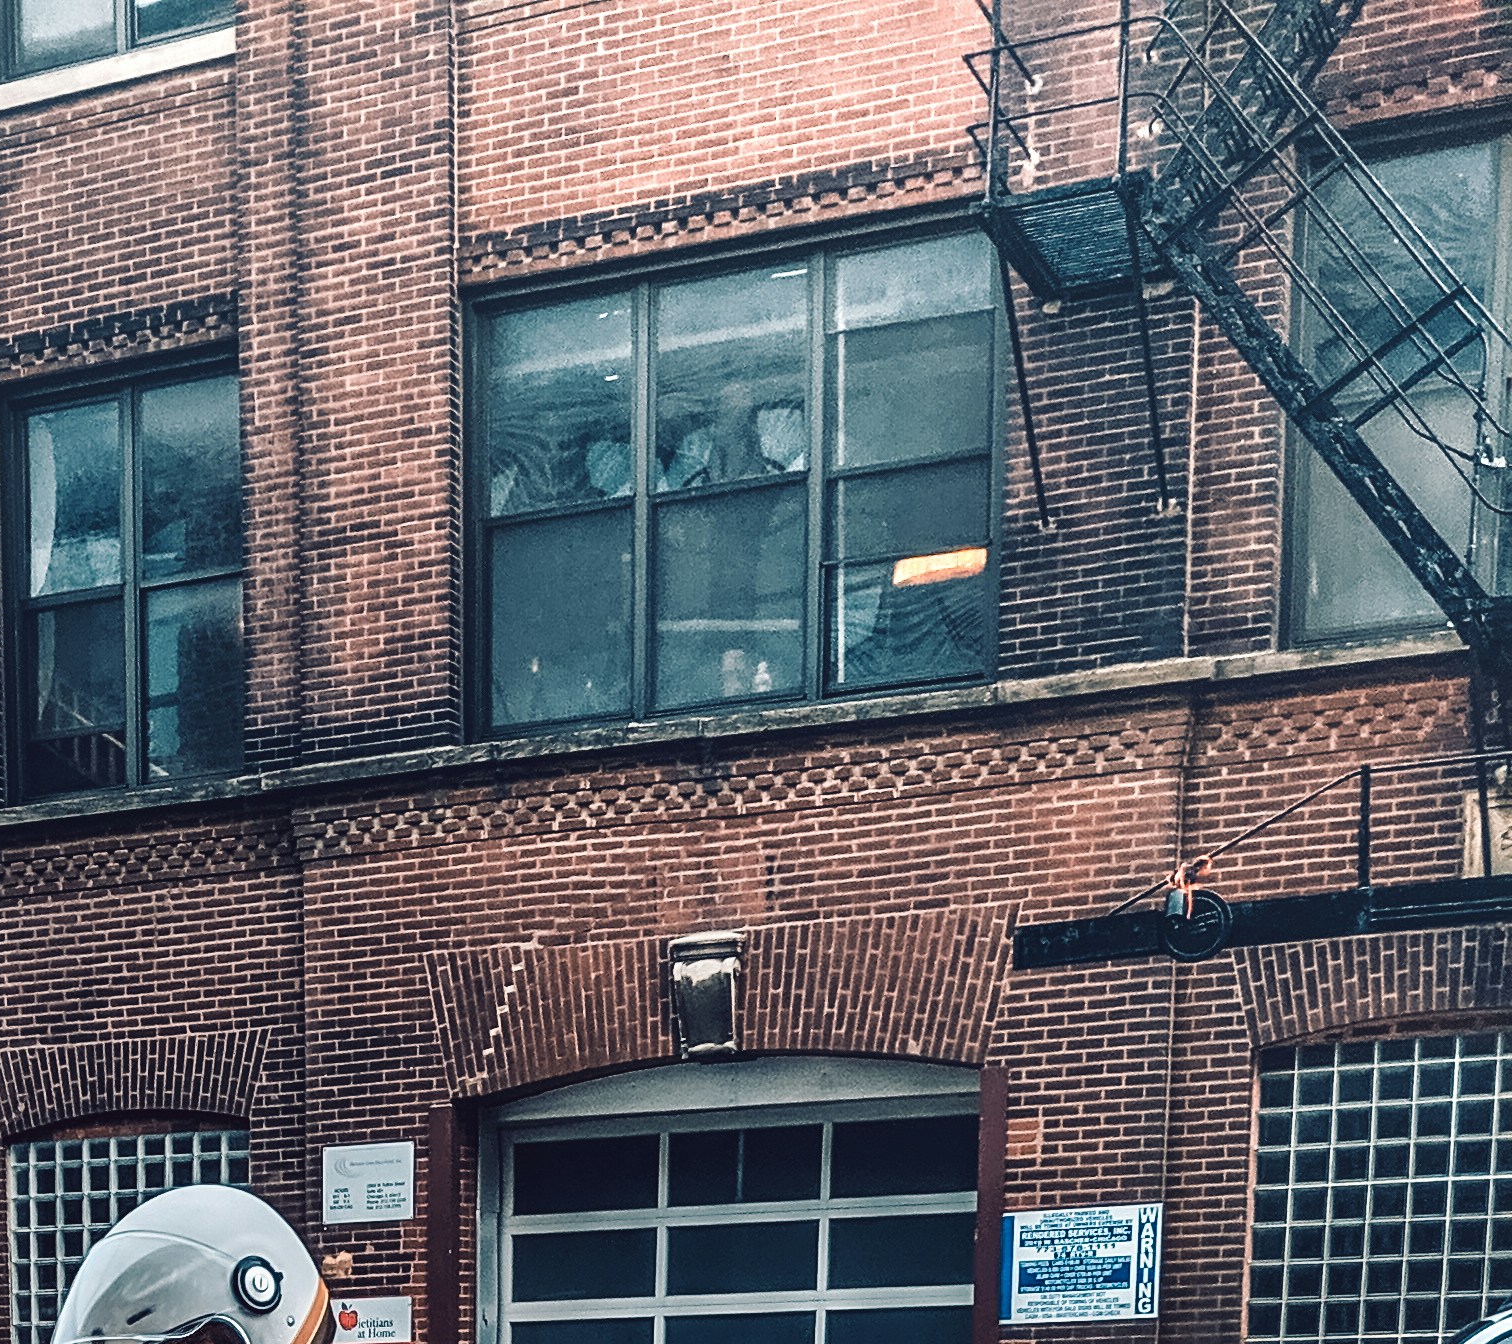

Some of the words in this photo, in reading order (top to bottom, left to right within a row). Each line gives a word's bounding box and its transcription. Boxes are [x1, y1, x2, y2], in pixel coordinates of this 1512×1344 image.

[1021, 1230, 1067, 1240] RENDERED
[1138, 1207, 1159, 1314] WARNING
[368, 1328, 396, 1339] Home
